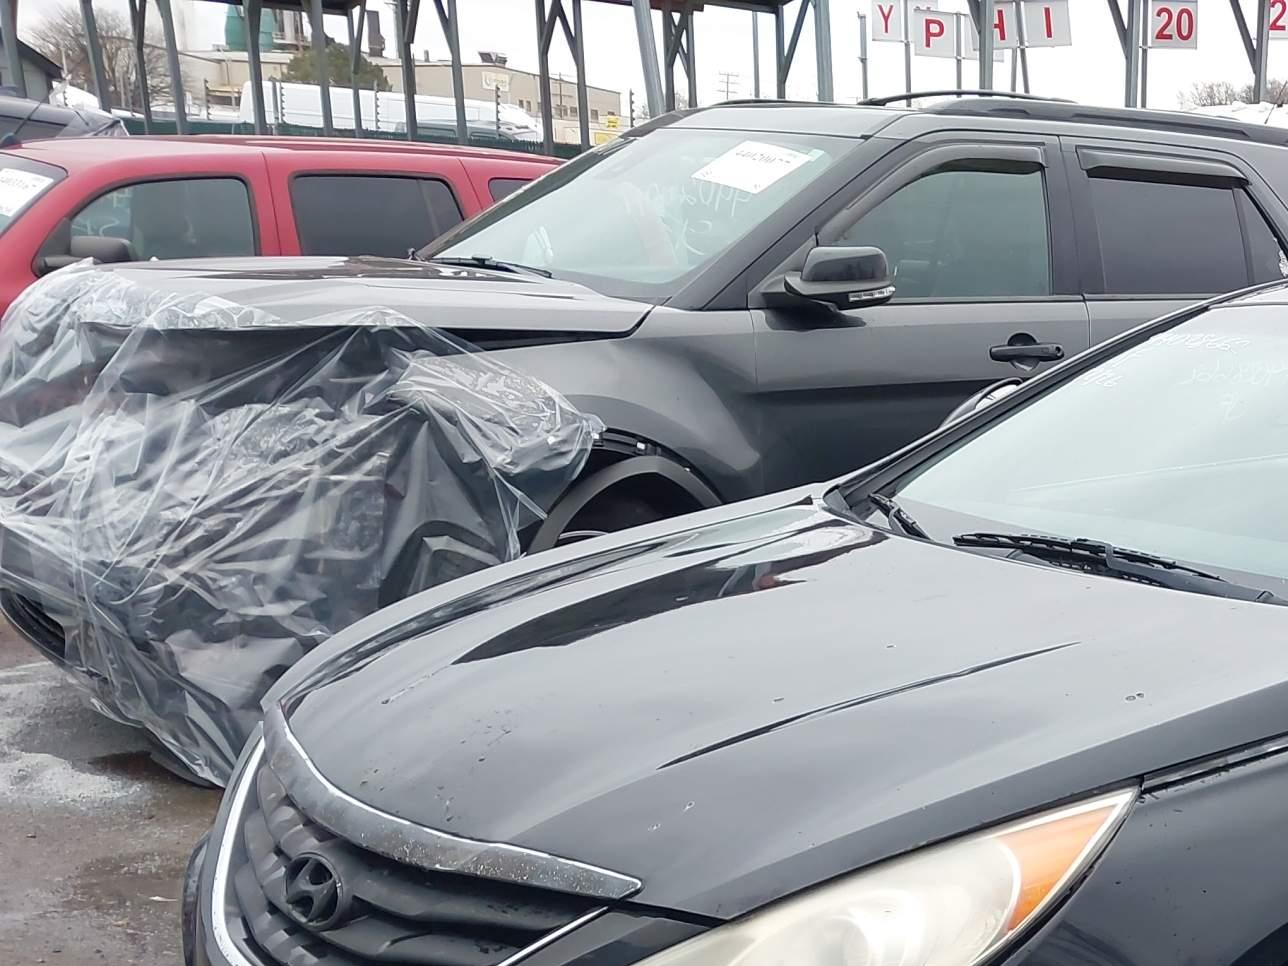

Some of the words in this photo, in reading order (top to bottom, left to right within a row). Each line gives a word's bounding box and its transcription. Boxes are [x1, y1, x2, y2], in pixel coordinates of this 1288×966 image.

[876, 4, 893, 34] Y
[925, 18, 945, 48] P
[1155, 6, 1194, 41] 20
